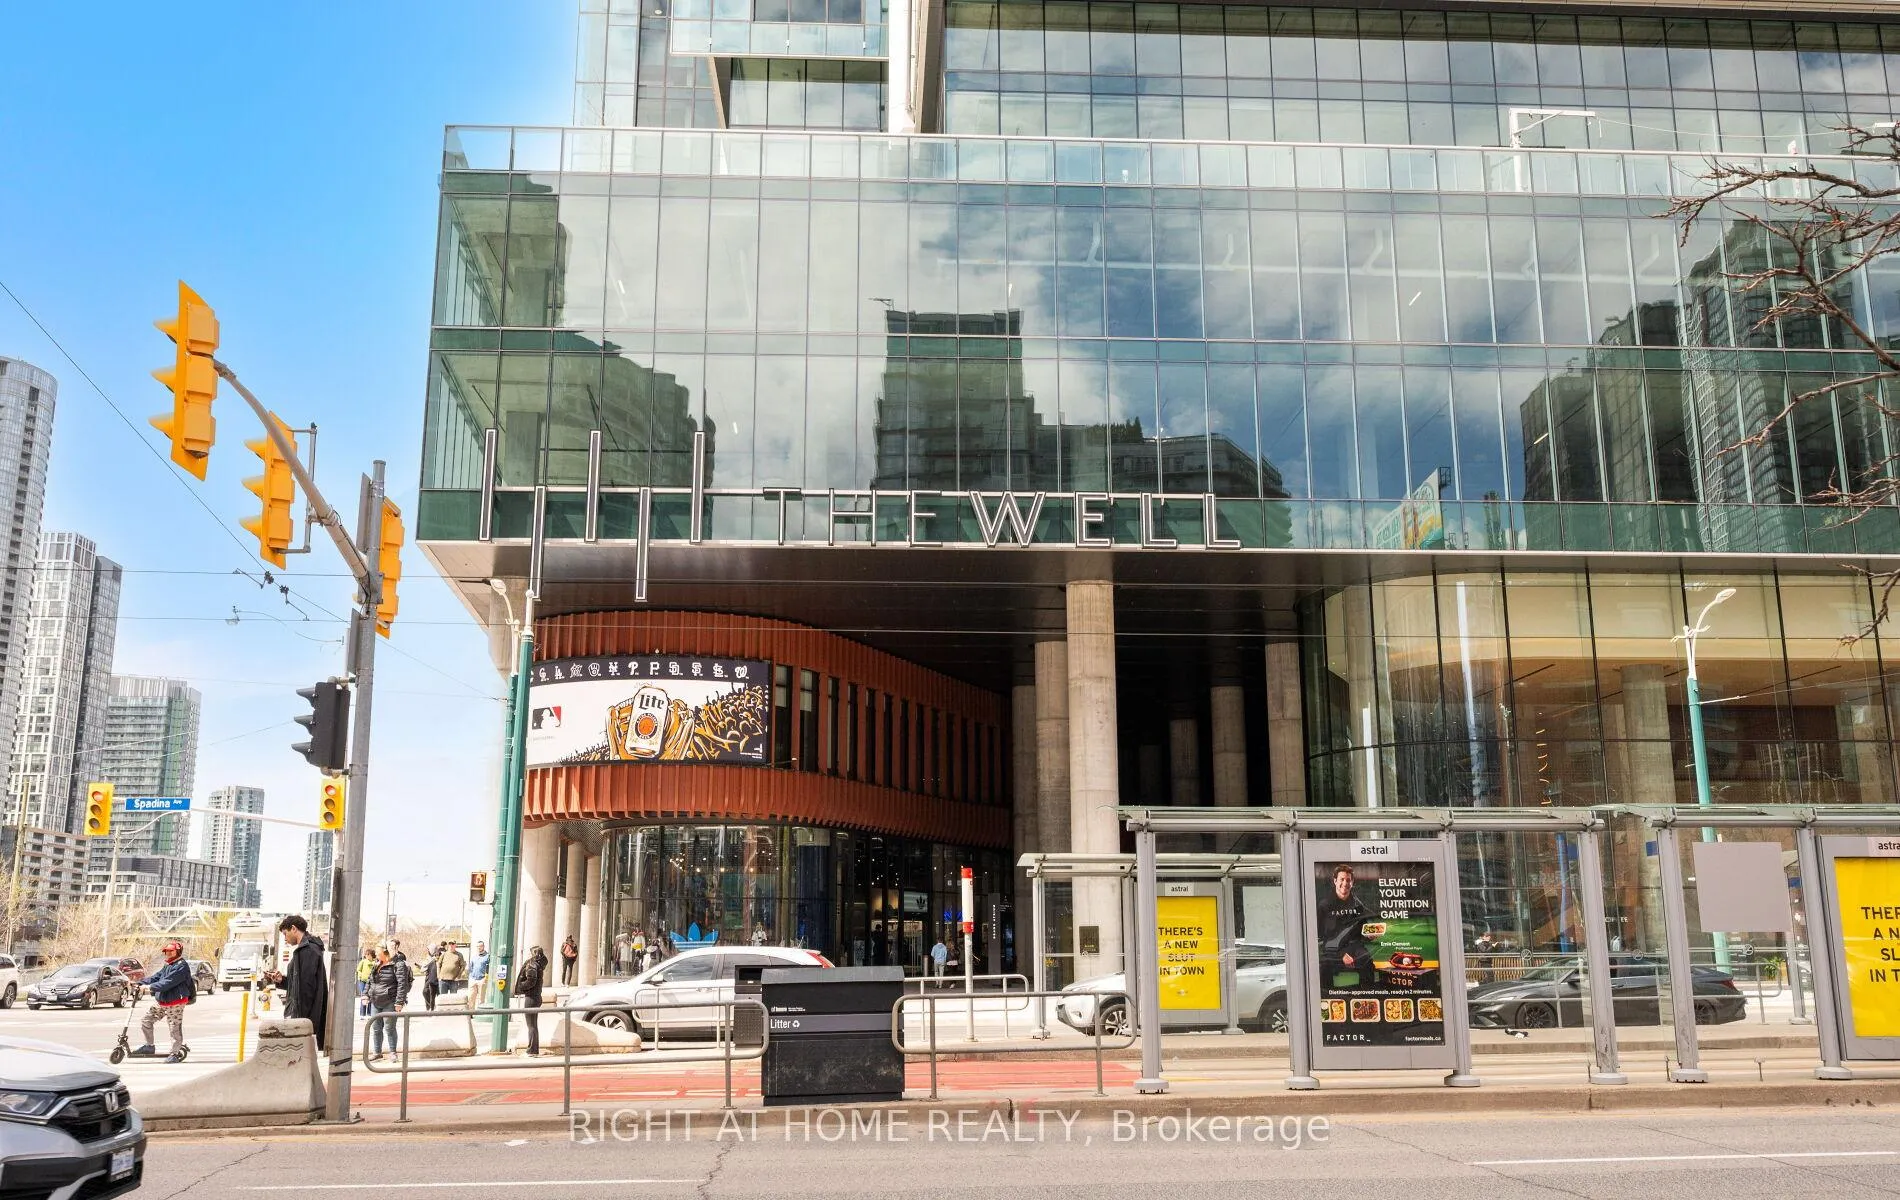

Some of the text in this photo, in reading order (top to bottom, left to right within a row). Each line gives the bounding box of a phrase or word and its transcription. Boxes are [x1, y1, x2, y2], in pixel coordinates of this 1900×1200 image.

[763, 487, 1242, 551] THE WELL
[638, 694, 665, 710] Lite
[133, 798, 171, 810] Spadina
[1360, 845, 1388, 855] astral
[1378, 878, 1418, 887] ELEVATE
[1379, 888, 1407, 898] YOUR
[1380, 899, 1430, 909] NUTRITION
[1380, 910, 1409, 920] GAME
[1158, 927, 1203, 936] THERE'S
[1873, 926, 1884, 941] A
[1164, 940, 1198, 948] A NEW
[1159, 966, 1205, 976] IN TOWN
[1869, 968, 1887, 982] IN
[770, 1018, 791, 1029] Litter
